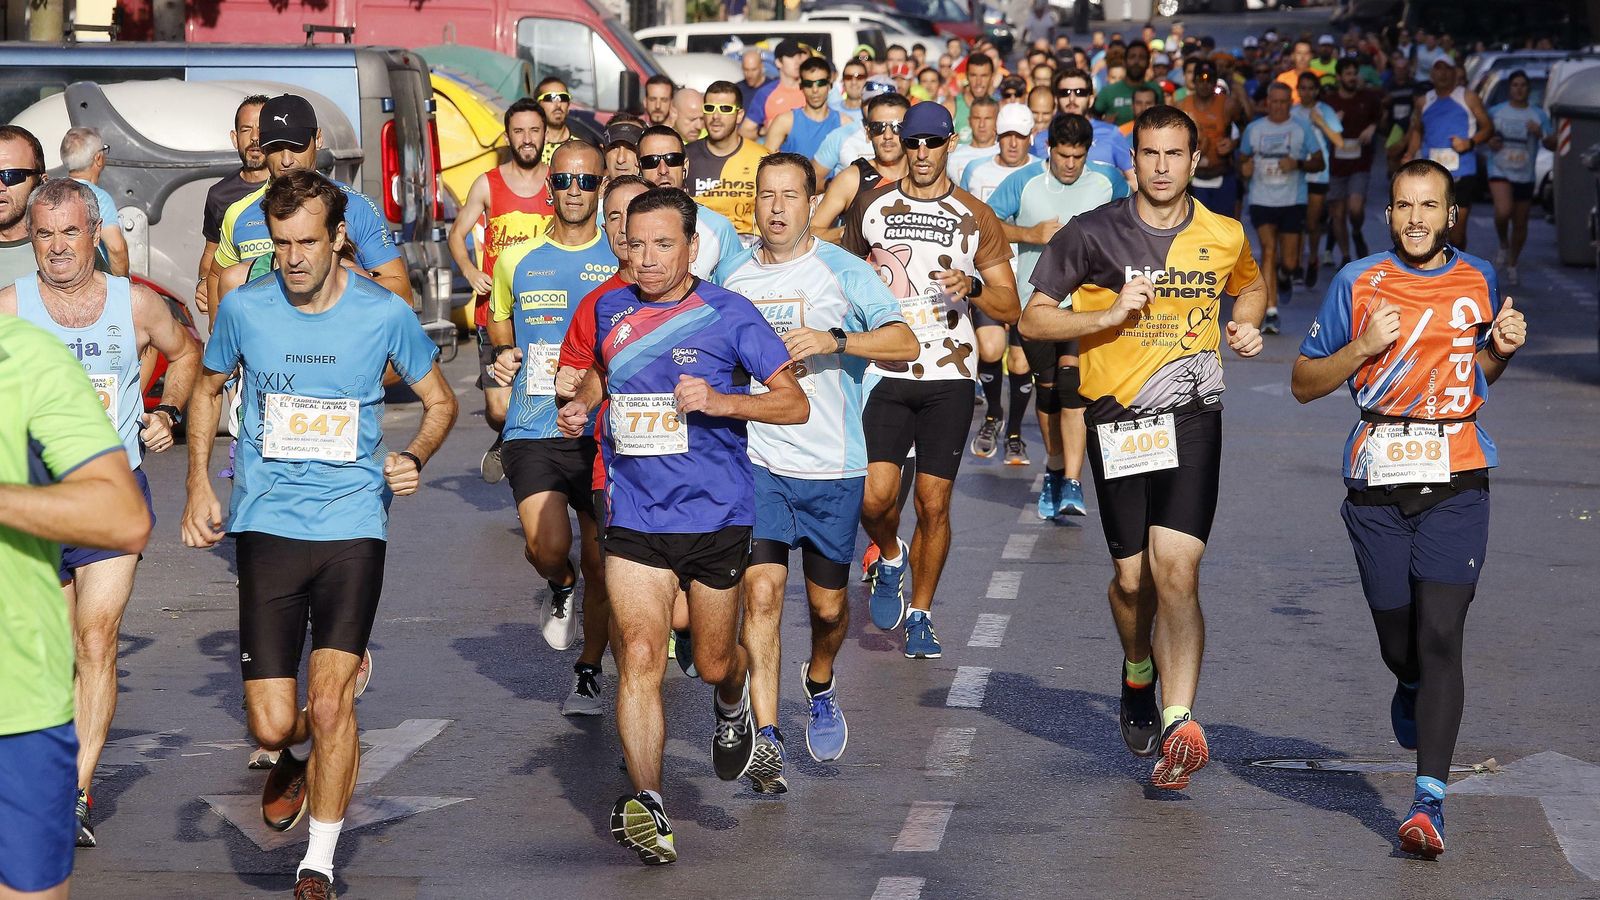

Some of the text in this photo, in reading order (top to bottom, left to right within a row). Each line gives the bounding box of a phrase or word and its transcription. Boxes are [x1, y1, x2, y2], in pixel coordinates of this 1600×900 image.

[696, 178, 755, 191] bichos
[695, 190, 754, 198] runners
[886, 214, 955, 231] COCHINOS
[886, 228, 951, 245] RUNNERS
[1369, 270, 1387, 288] vive
[520, 292, 566, 304] naocon
[1156, 313, 1179, 321] Oficial
[1146, 322, 1179, 330] Gestores
[1115, 330, 1178, 338] Administrativos
[672, 348, 697, 356] REGALA
[285, 354, 337, 364] FINISHER
[1429, 368, 1439, 394] Grupo
[291, 402, 319, 410] TORCAL
[333, 403, 348, 411] PAZ
[289, 412, 351, 437] 647
[625, 411, 680, 432] 776
[1121, 430, 1169, 454] 406
[281, 445, 320, 454] DISMOAUTO
[1386, 440, 1442, 461] 698
